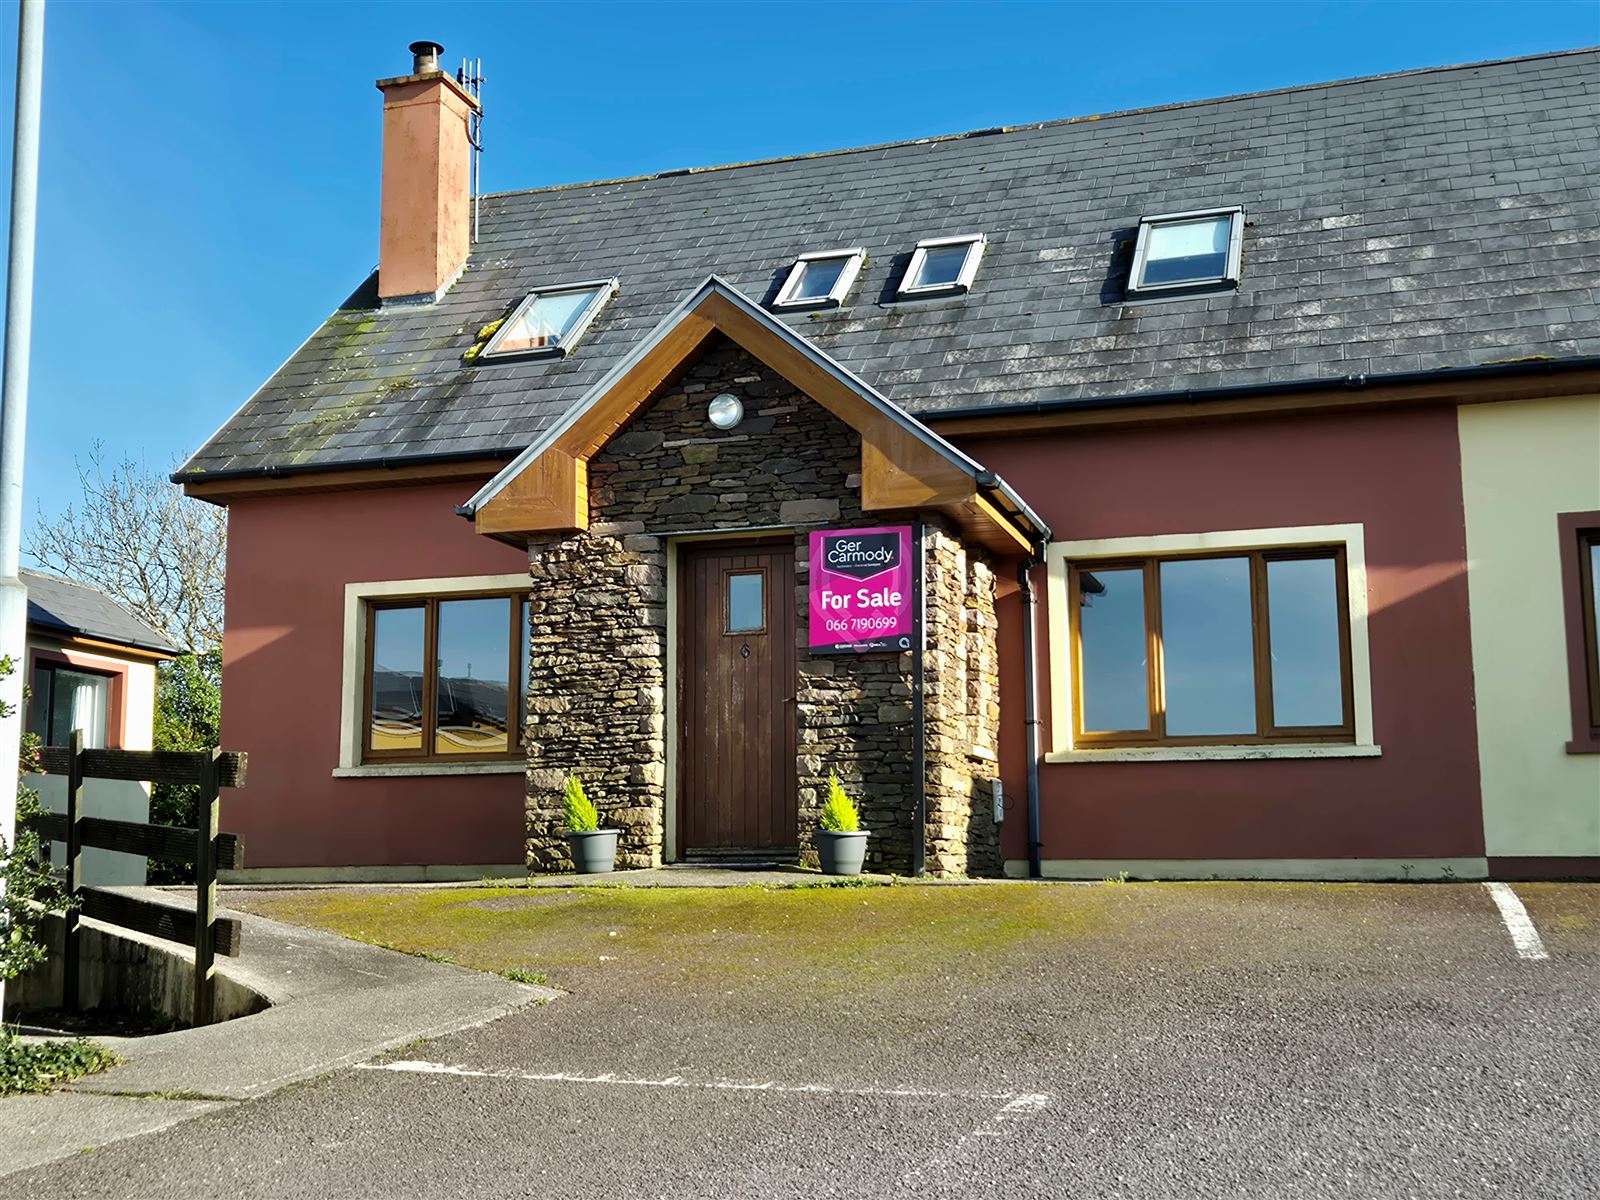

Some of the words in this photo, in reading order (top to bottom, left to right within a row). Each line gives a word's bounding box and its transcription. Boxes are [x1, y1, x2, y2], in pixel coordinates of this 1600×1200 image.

[836, 539, 862, 551] Ger
[828, 547, 893, 562] Carmody
[822, 591, 851, 609] For
[857, 587, 901, 608] Sale
[826, 619, 848, 631] 066
[851, 617, 897, 629] 7190699
